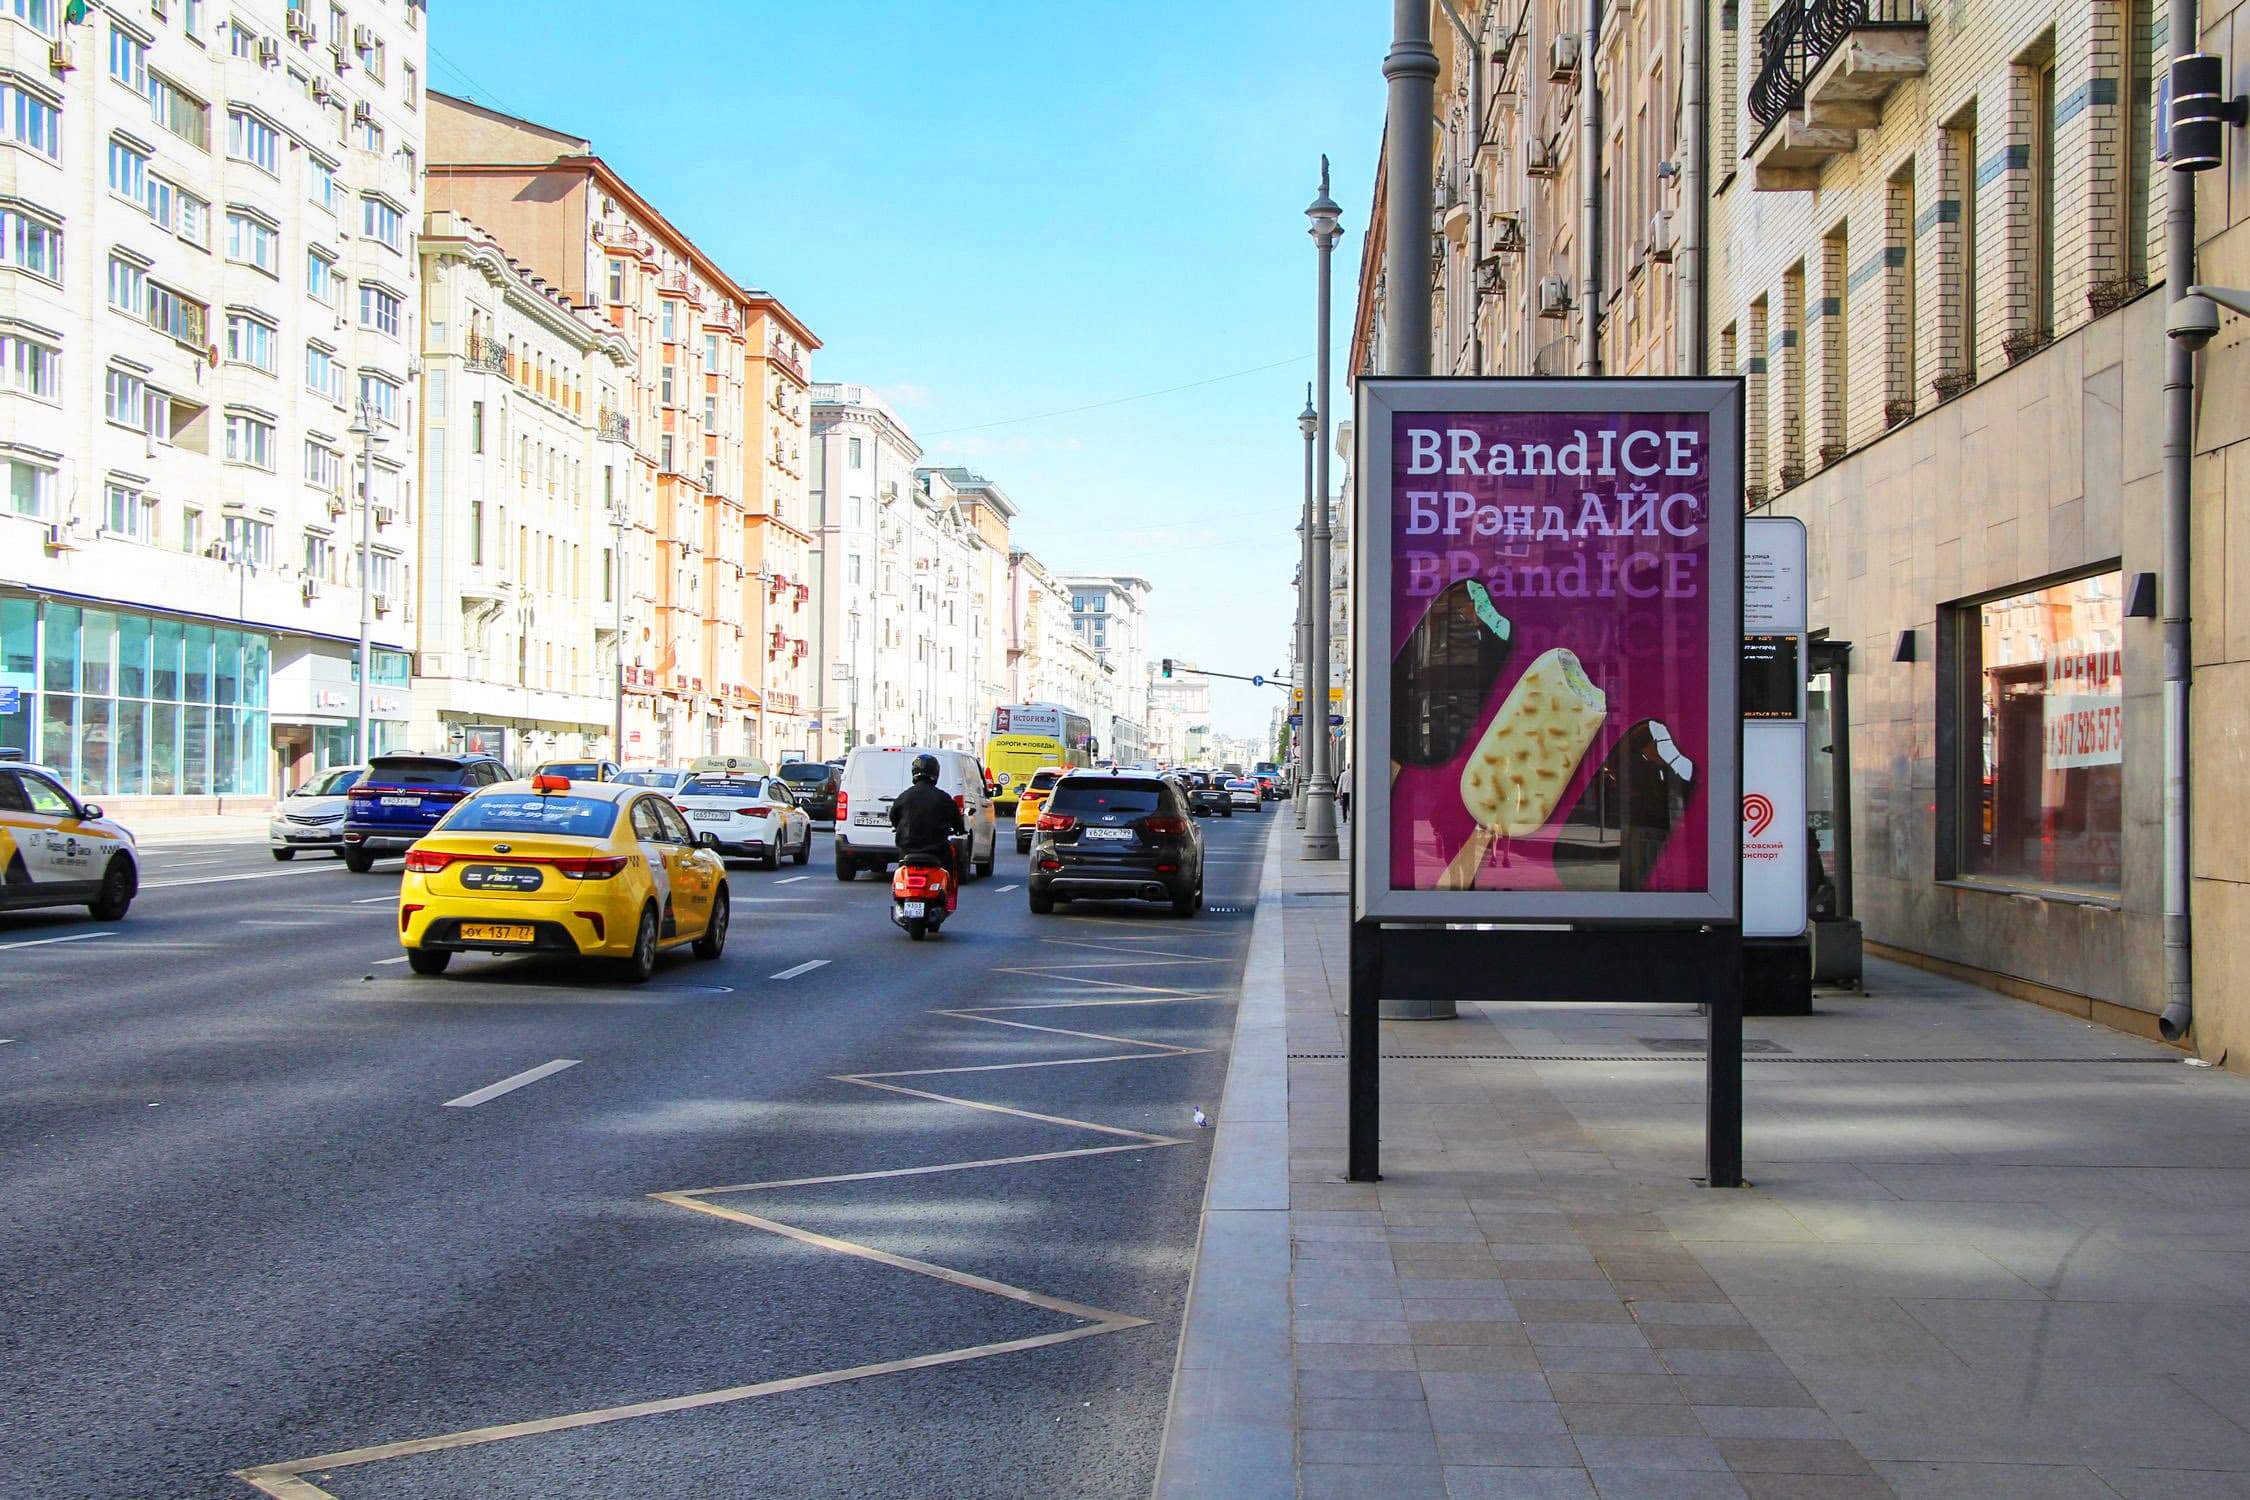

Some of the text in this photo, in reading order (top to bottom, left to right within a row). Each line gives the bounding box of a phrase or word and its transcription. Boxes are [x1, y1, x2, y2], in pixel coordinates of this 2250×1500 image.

[1406, 429, 1698, 477] BRandICE
[1405, 481, 1699, 542] БРэндАЙС
[2053, 651, 2122, 693] АРЕНДА
[1013, 714, 1057, 723] ИСТОРИЯ.РФ
[2058, 712, 2075, 756] 977
[2077, 709, 2096, 755] 526
[2098, 707, 2112, 753] 57
[1743, 852, 1779, 860] анспорт
[487, 873, 515, 883] FIRST
[488, 925, 511, 938] 137
[519, 926, 531, 938] 77
